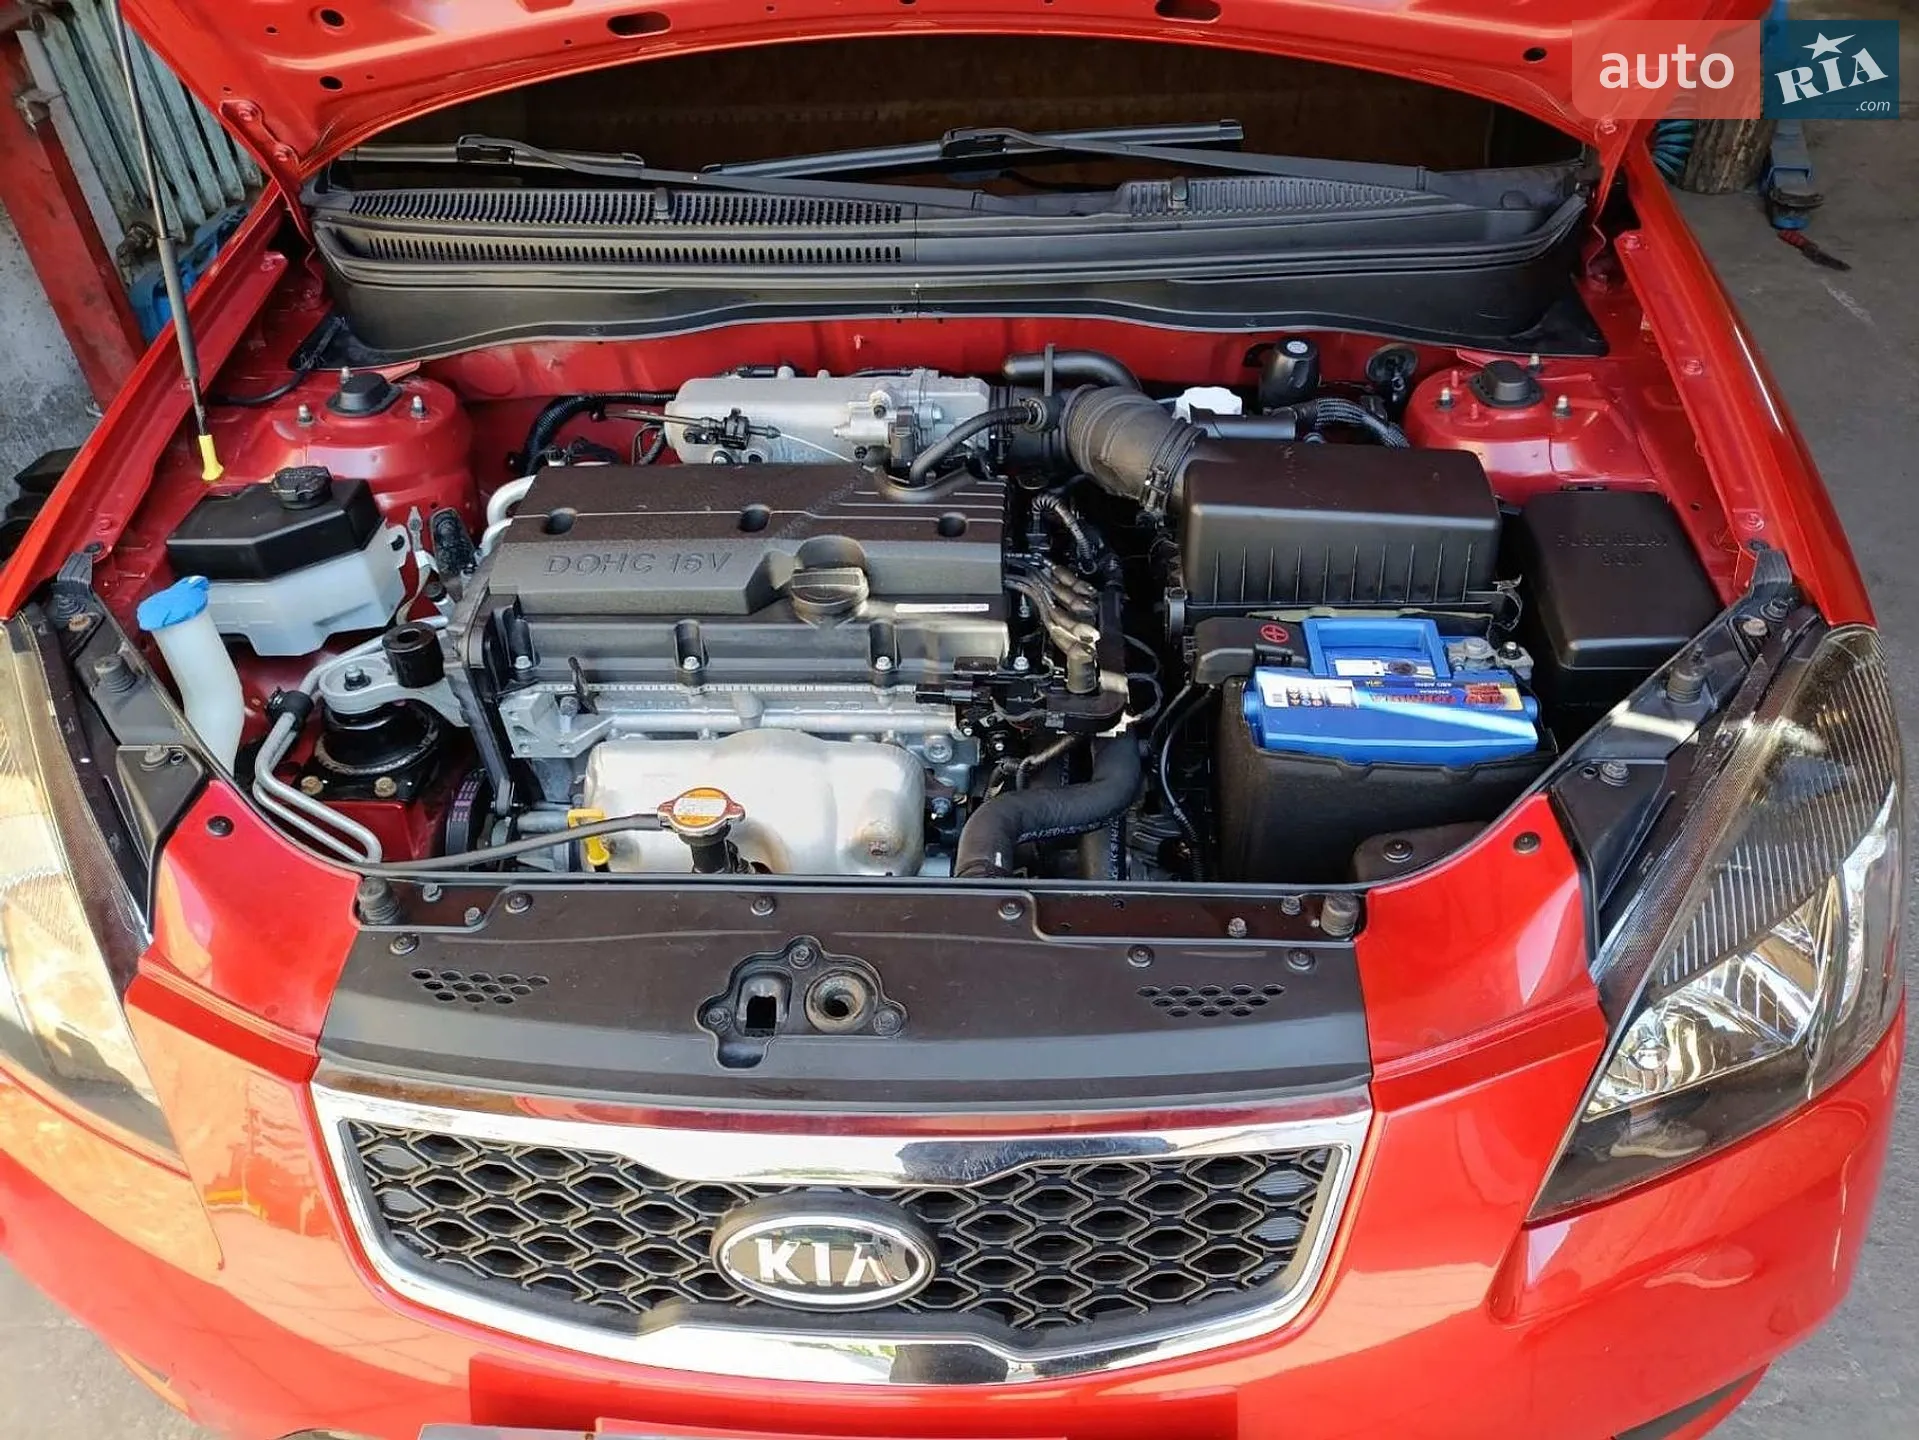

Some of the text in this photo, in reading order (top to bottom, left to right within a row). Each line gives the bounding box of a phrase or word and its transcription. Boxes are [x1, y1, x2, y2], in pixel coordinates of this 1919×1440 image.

[544, 552, 732, 576] DOHC 16V
[754, 1238, 895, 1287] KIA
